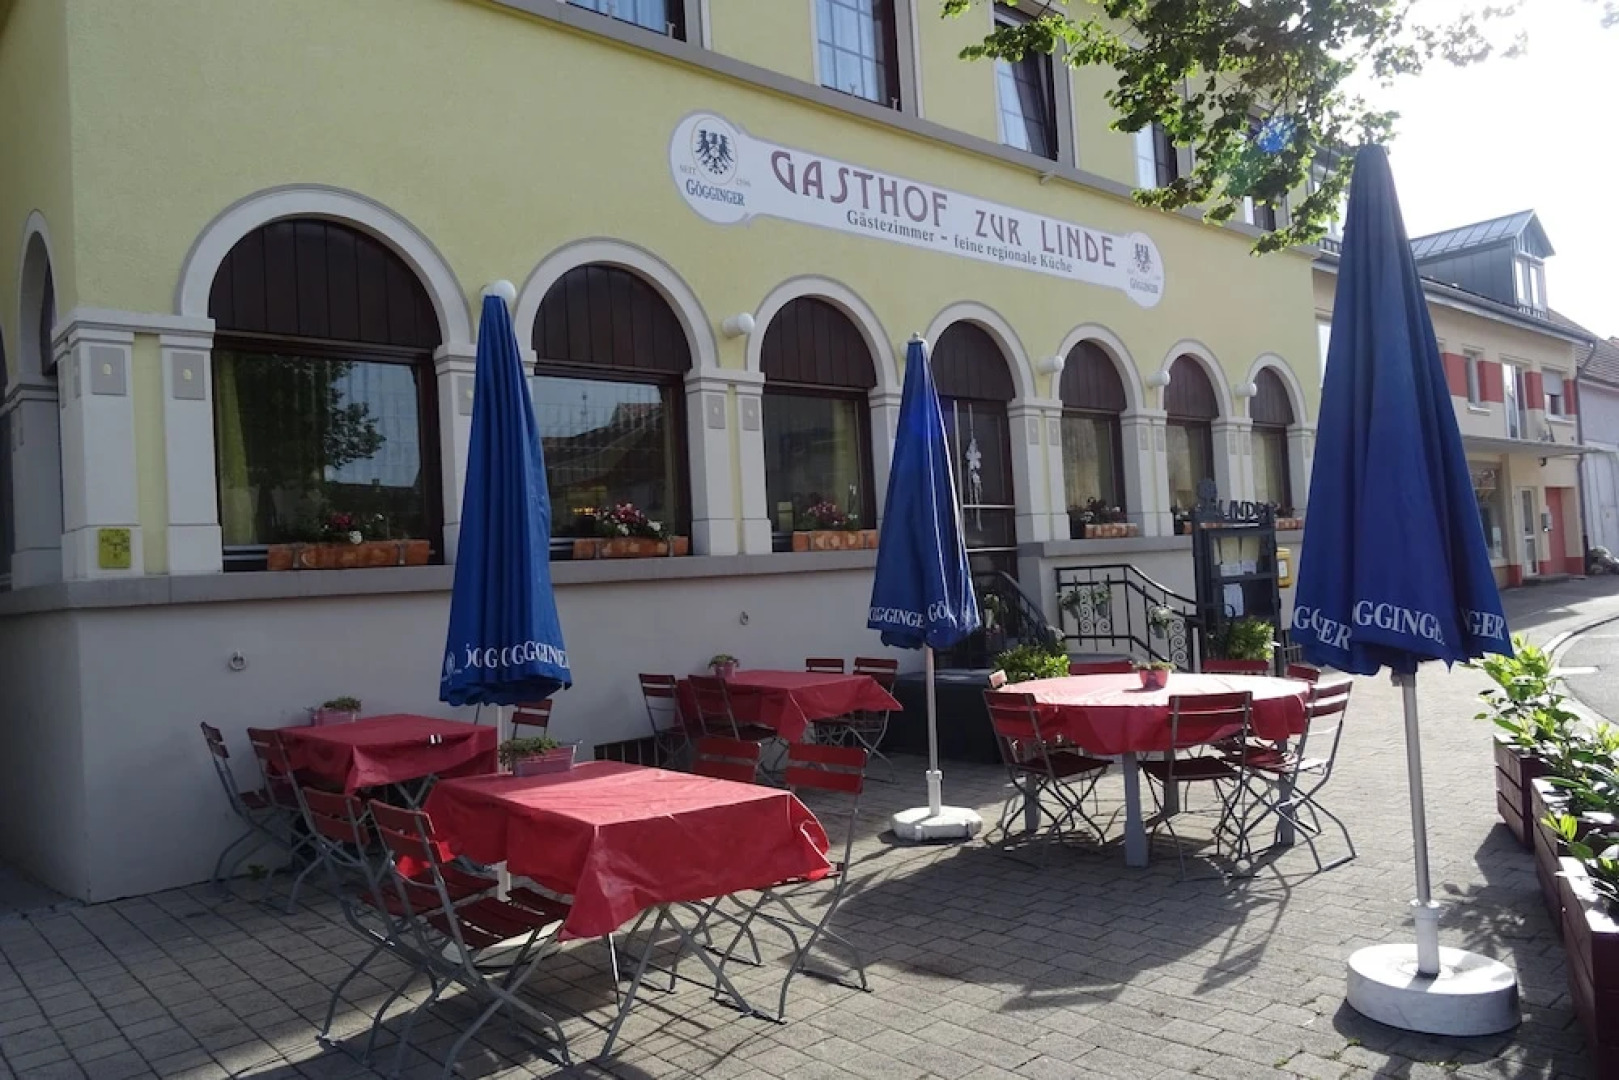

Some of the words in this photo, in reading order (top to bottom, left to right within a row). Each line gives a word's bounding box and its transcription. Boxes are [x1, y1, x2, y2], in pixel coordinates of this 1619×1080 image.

[770, 150, 948, 227] GASTHOF
[975, 209, 1022, 246] ZUR
[1040, 219, 1116, 267] LINDE
[846, 209, 935, 242] Gästezimmer
[954, 234, 984, 254] feine
[986, 244, 1037, 265] regionale
[1040, 253, 1073, 273] Küche
